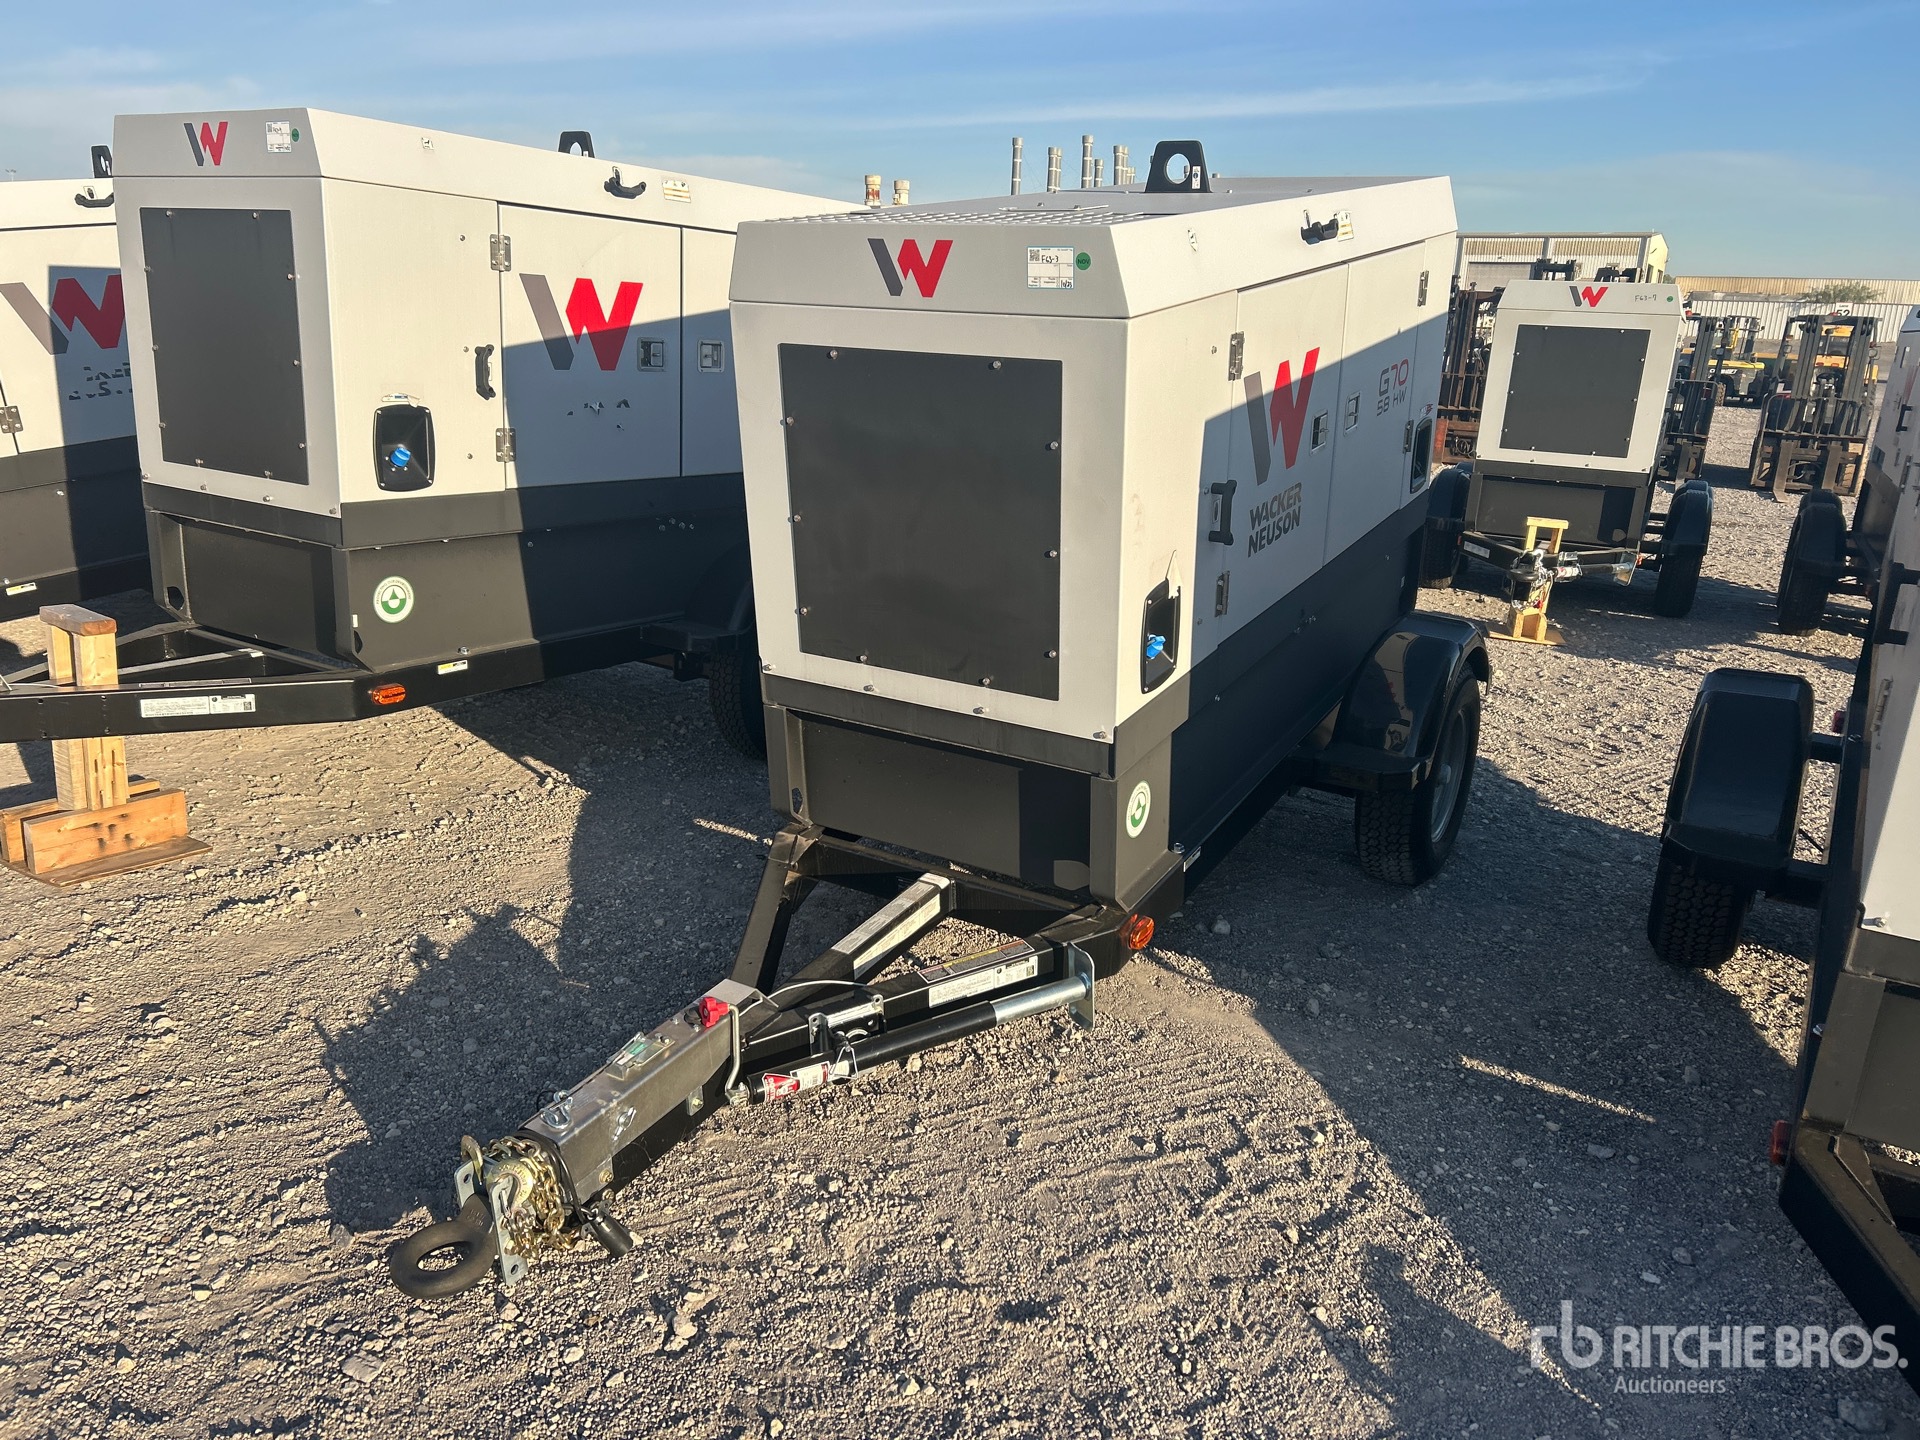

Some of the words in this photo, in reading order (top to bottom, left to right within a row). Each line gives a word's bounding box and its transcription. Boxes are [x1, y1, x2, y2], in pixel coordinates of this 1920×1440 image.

[1379, 358, 1409, 397] G70
[1249, 482, 1302, 531] WACKER
[1247, 505, 1302, 558] NEUSON
